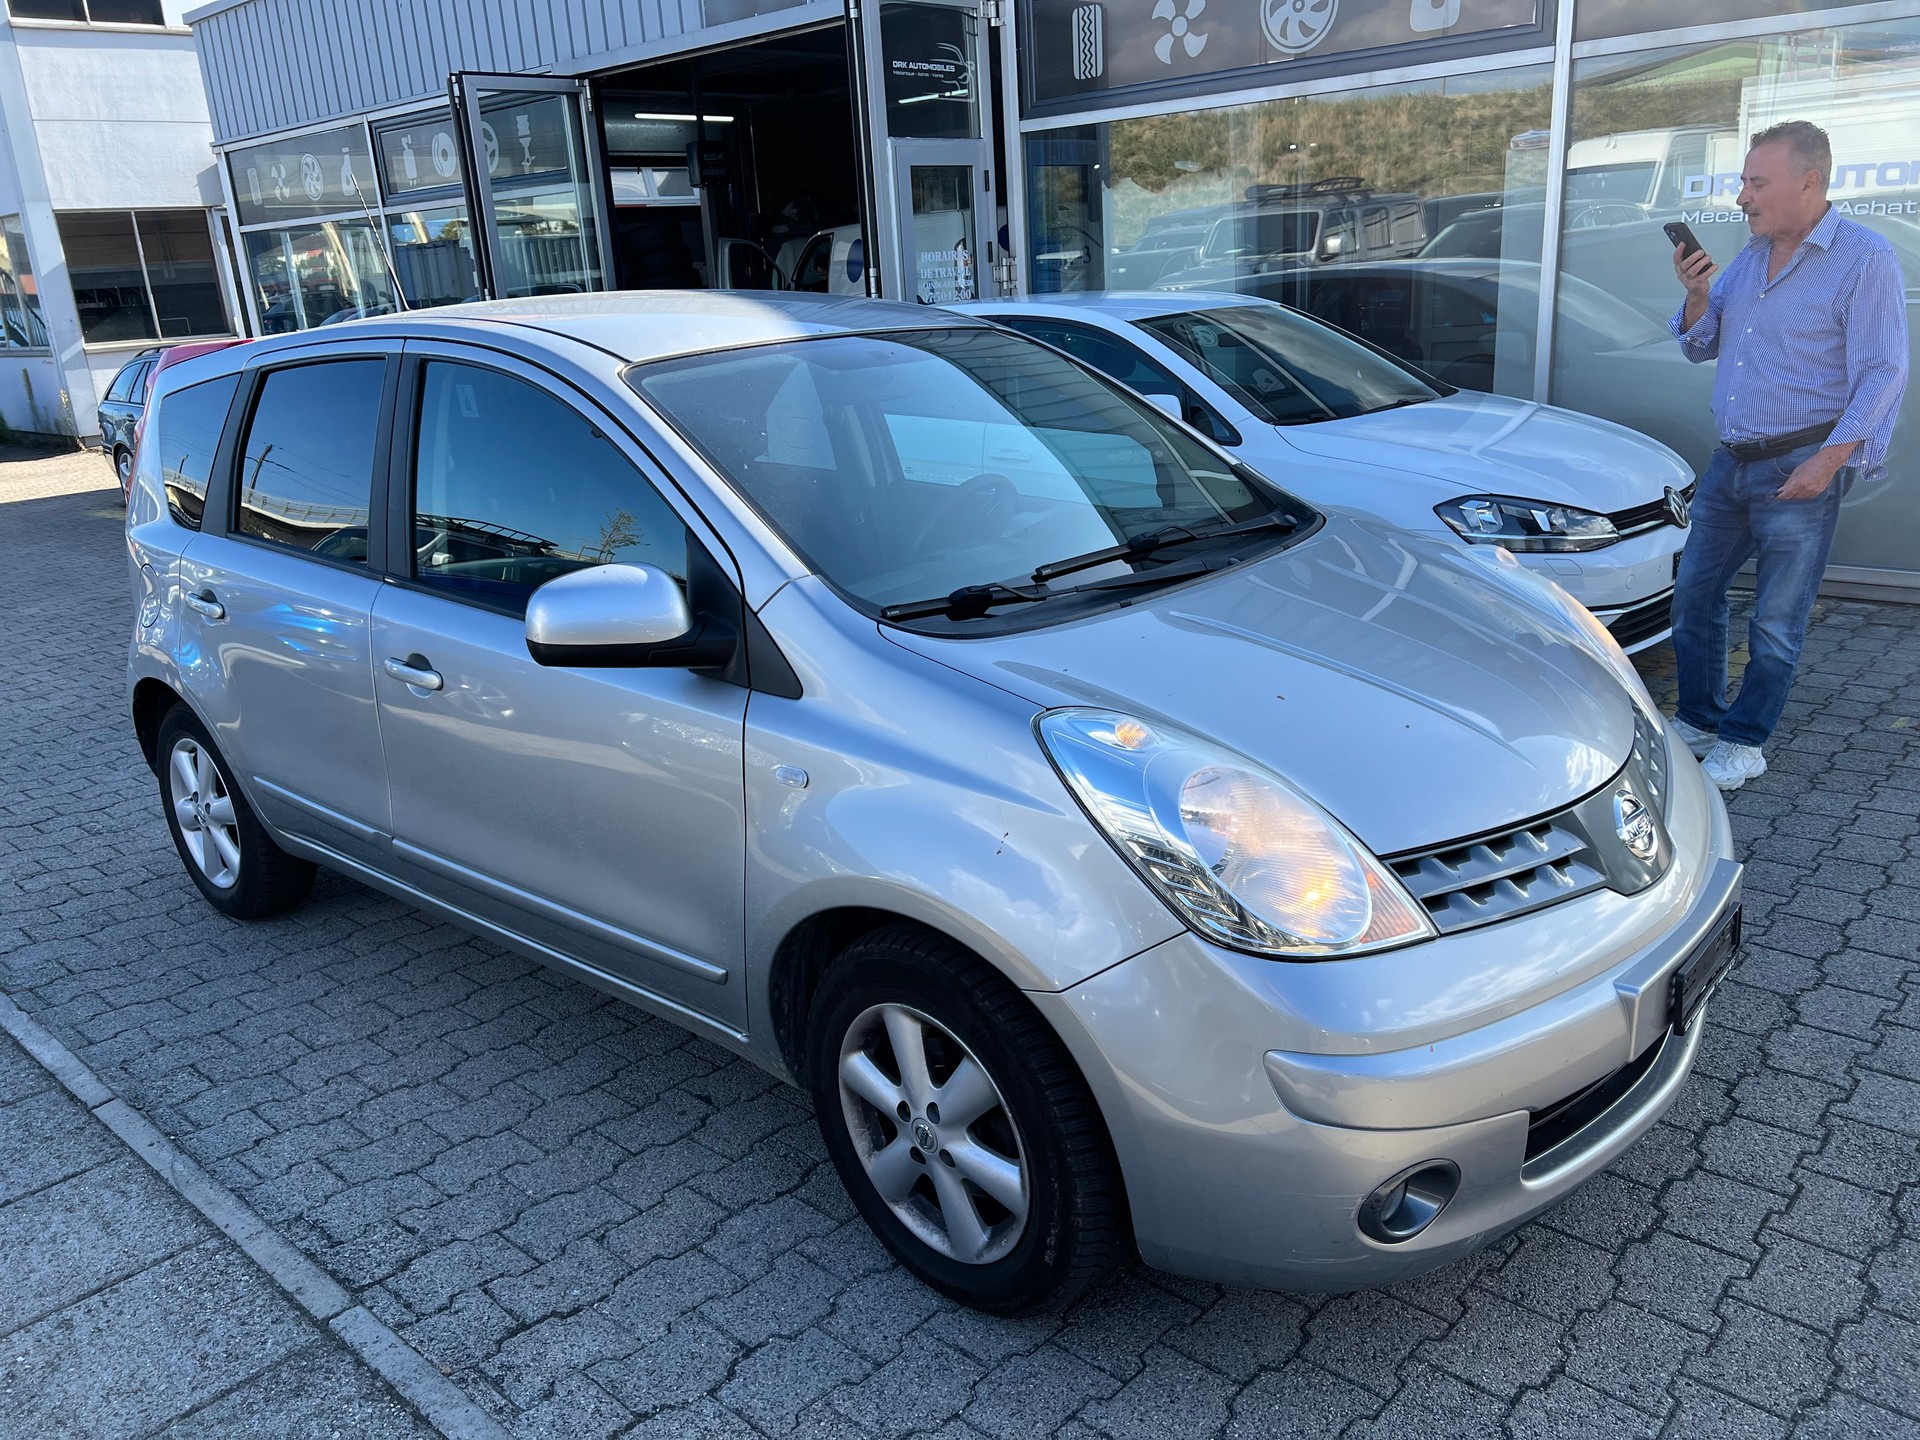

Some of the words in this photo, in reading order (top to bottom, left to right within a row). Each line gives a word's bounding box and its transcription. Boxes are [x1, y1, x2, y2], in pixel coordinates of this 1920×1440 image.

[908, 62, 955, 72] AUTOMOBILES
[1683, 172, 1743, 199] DR
[1681, 210, 1749, 225] Meca
[1837, 199, 1918, 216] Achat
[920, 267, 933, 279] DE
[934, 266, 971, 278] TRAVL
